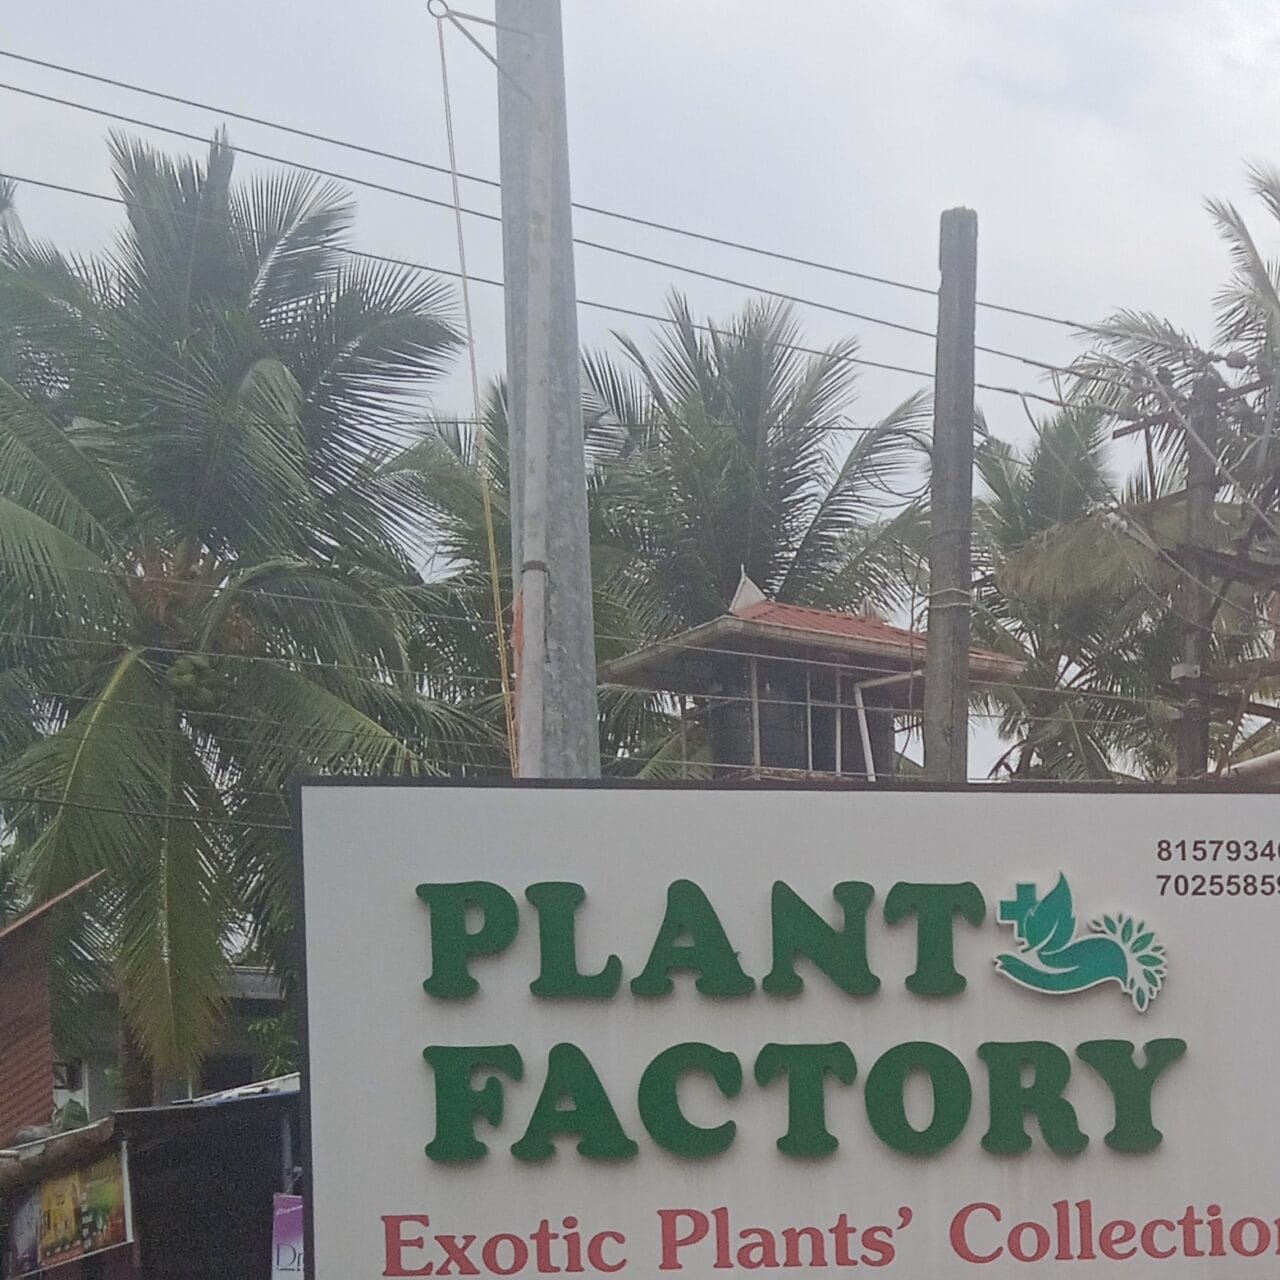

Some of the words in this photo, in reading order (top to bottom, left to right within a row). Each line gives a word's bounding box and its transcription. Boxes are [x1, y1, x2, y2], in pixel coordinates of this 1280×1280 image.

[415, 879, 987, 998] PLANT
[422, 1037, 1187, 1163] FACTORY
[381, 1214, 627, 1277] Exotic
